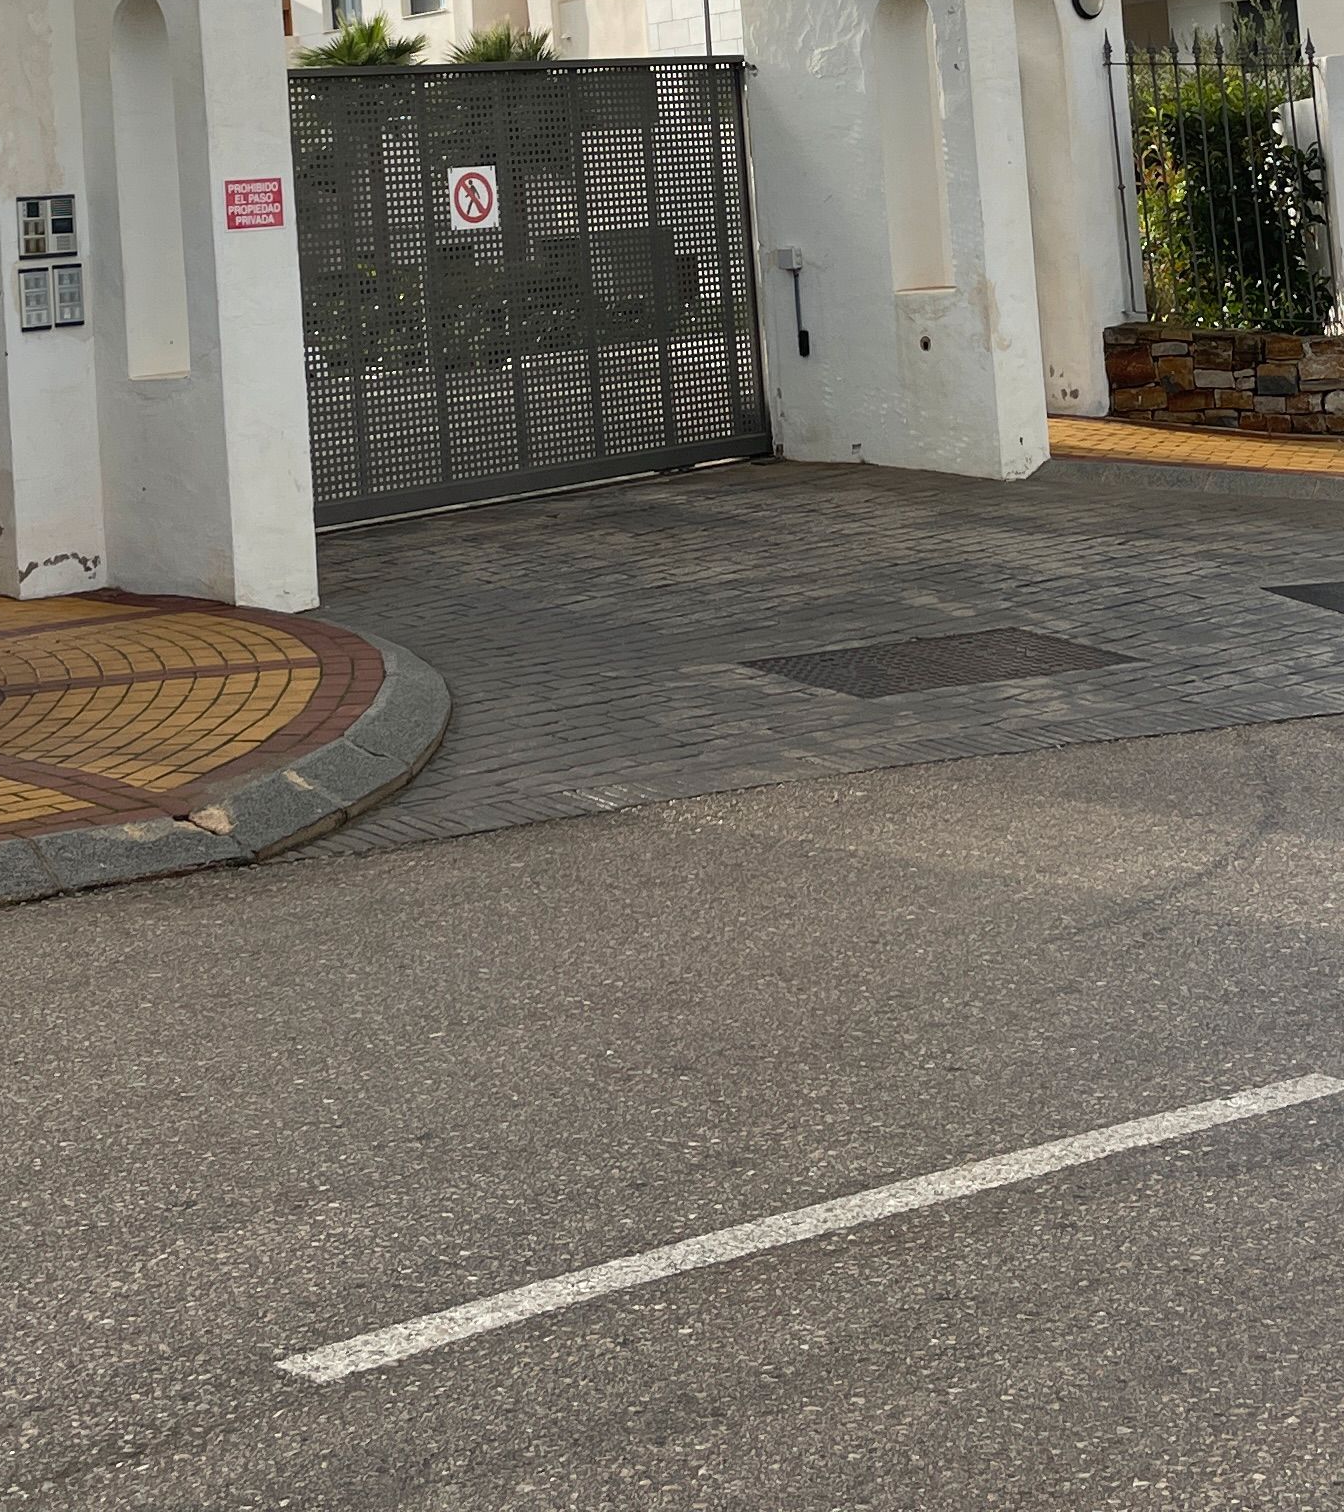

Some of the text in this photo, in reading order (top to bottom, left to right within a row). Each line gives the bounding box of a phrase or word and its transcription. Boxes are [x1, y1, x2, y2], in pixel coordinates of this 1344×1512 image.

[227, 182, 279, 194] PROHIBIDO
[234, 193, 274, 205] EL PASO
[228, 203, 281, 216] PROPIEDAD
[236, 214, 275, 226] PRIVADA
